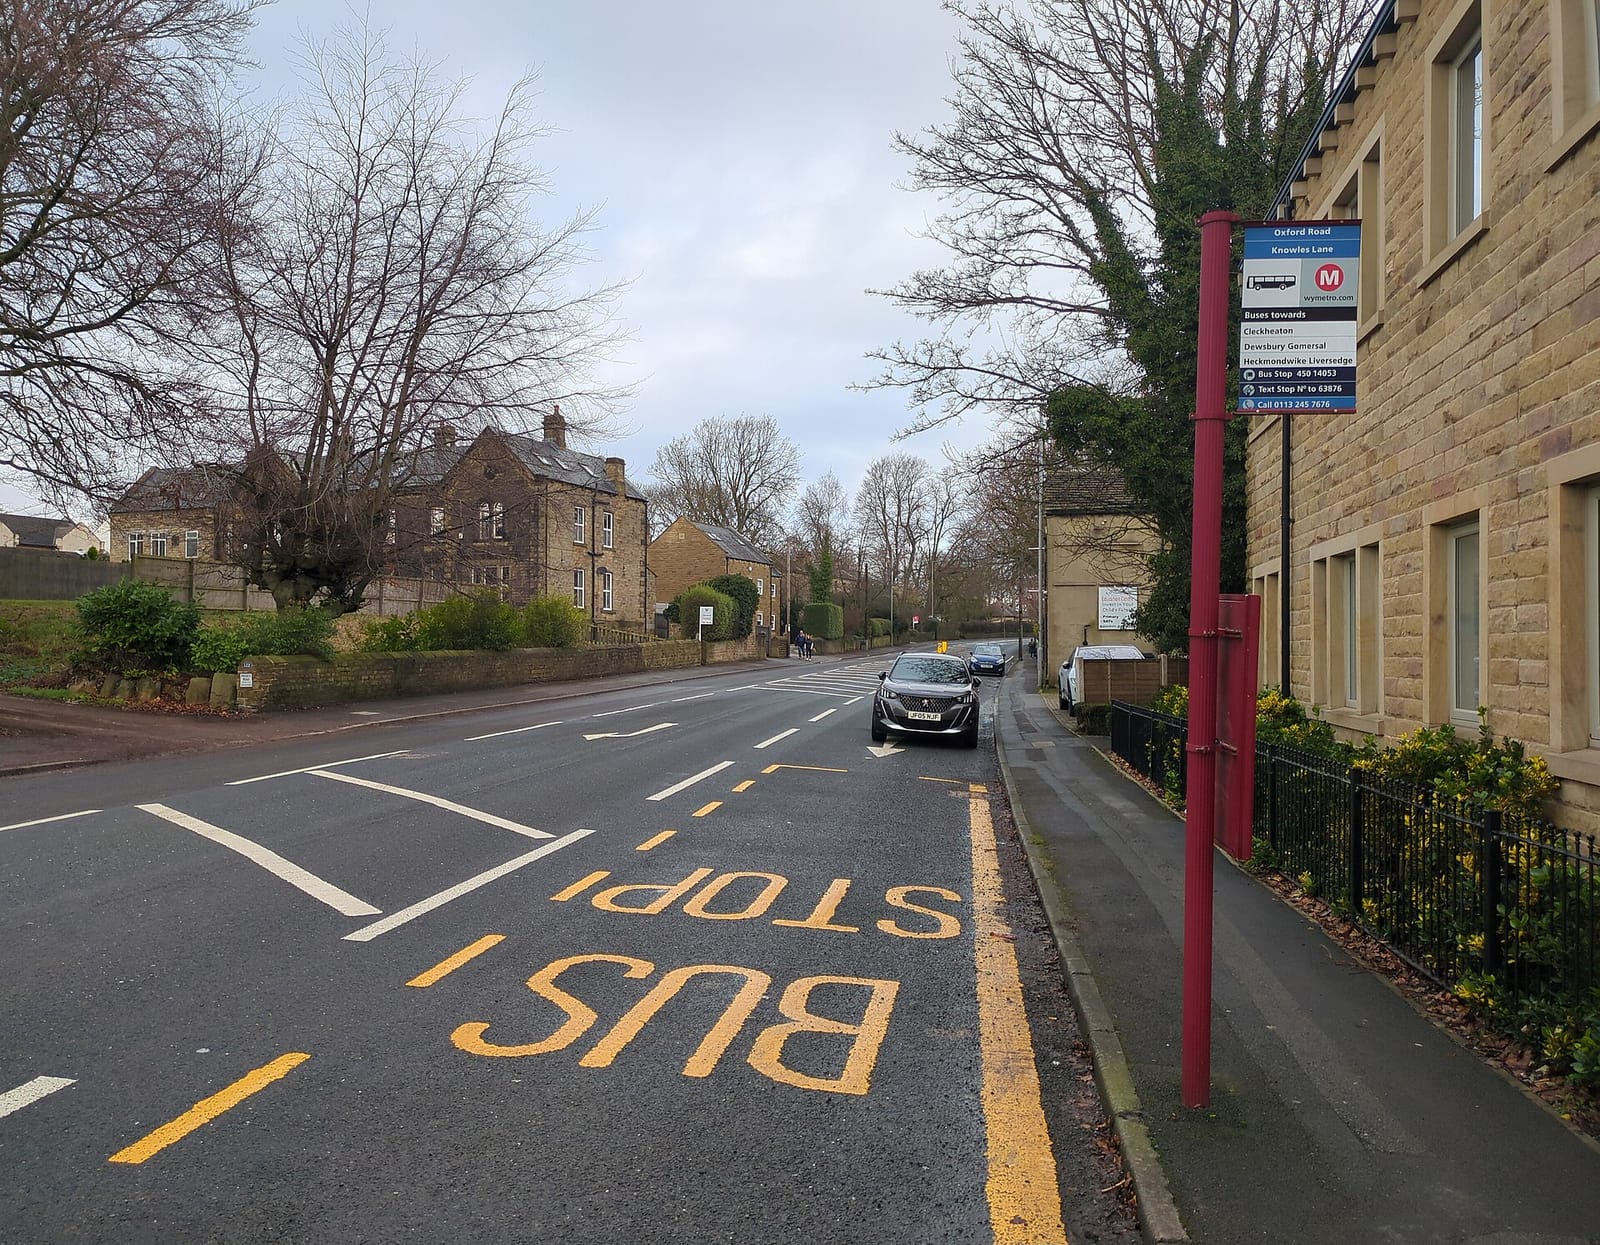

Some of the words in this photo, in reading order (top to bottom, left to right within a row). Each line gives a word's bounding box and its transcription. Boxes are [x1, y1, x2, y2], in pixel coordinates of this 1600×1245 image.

[1274, 228, 1306, 236] Oxford
[1308, 227, 1331, 235] Road
[1272, 246, 1310, 254] Knowles
[1320, 270, 1339, 286] M
[1244, 311, 1269, 319] Buses
[1243, 327, 1294, 335] Cleckheaton
[1244, 343, 1285, 351] Dewsbury
[1287, 342, 1327, 350] Gomersal
[1243, 357, 1307, 365] Heckmondwike
[1309, 357, 1353, 365] Liversedge
[1274, 370, 1293, 378] Stop
[1277, 385, 1295, 393] Stop
[592, 868, 962, 939] STOP
[450, 953, 900, 1095] BUS
